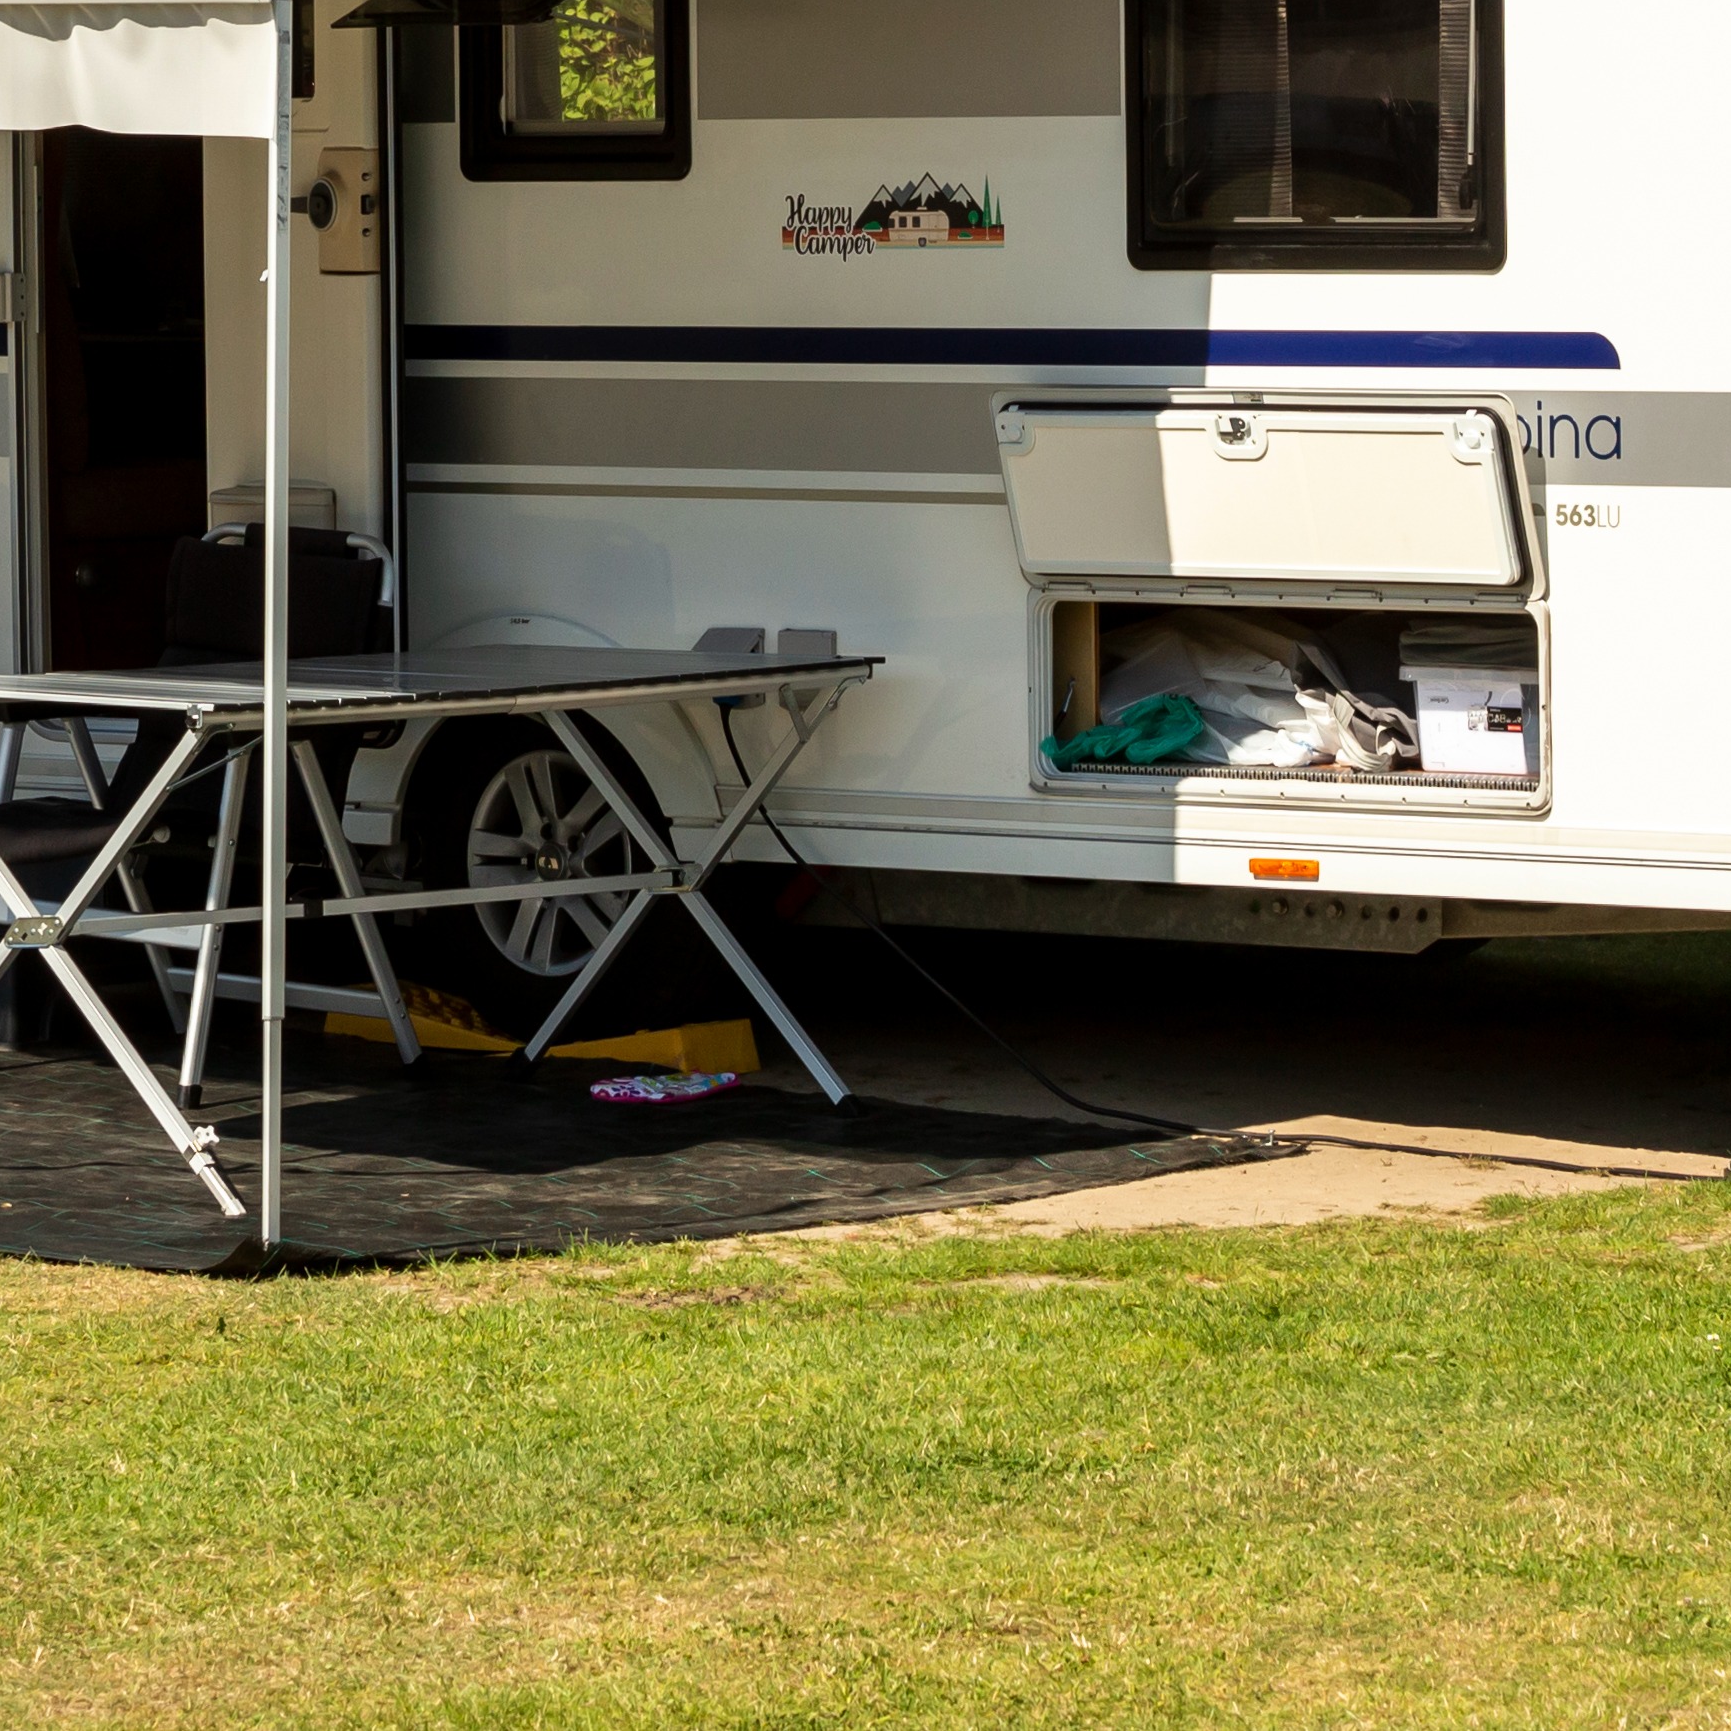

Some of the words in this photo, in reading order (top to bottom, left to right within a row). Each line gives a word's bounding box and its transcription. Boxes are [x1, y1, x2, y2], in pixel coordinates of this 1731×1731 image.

[785, 193, 853, 233] Happy
[794, 226, 876, 262] Camper
[1555, 503, 1621, 529] 563LU
